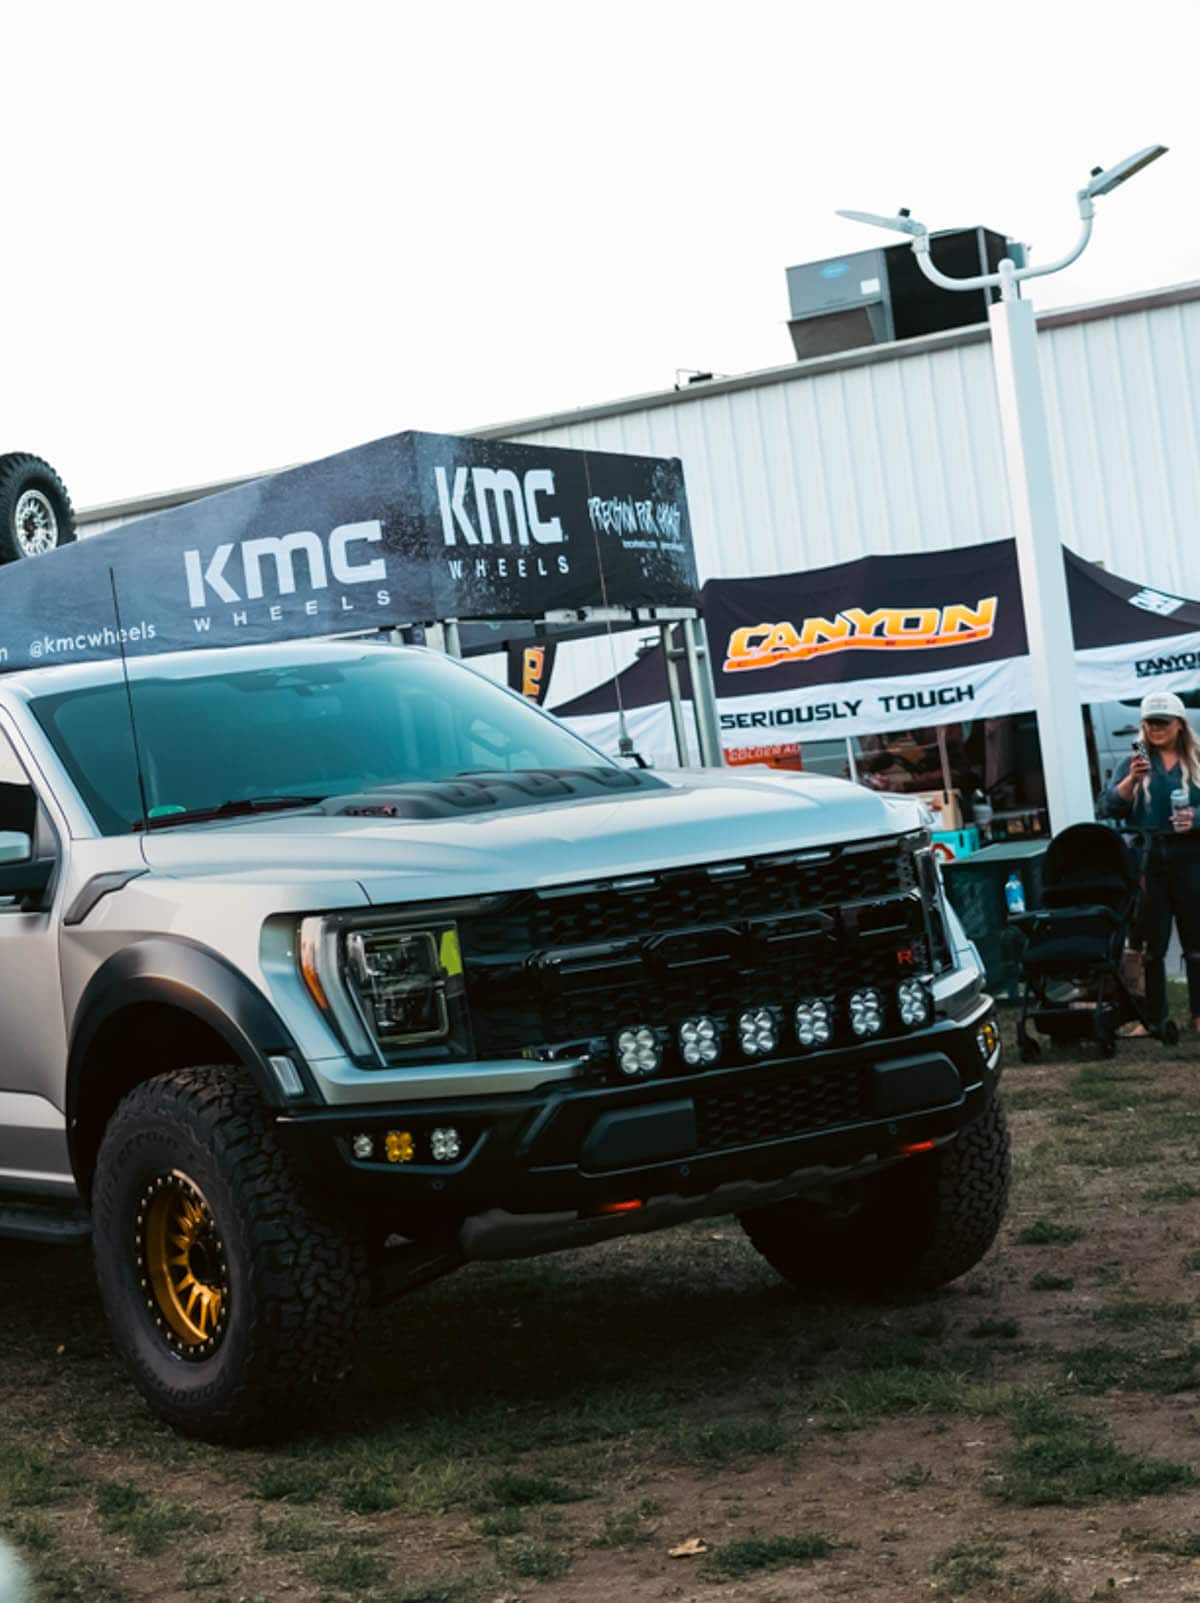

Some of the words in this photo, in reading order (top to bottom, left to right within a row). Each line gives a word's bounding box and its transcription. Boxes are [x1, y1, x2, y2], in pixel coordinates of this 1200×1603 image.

[448, 555, 569, 580] WHEELS
[193, 590, 391, 633] WHEELS
[726, 596, 998, 664] CANYON
[28, 620, 157, 659] @kmcwheels
[1135, 652, 1200, 673] CANYO
[719, 699, 863, 731] SERIOUSLY
[877, 684, 976, 713] TOUCH
